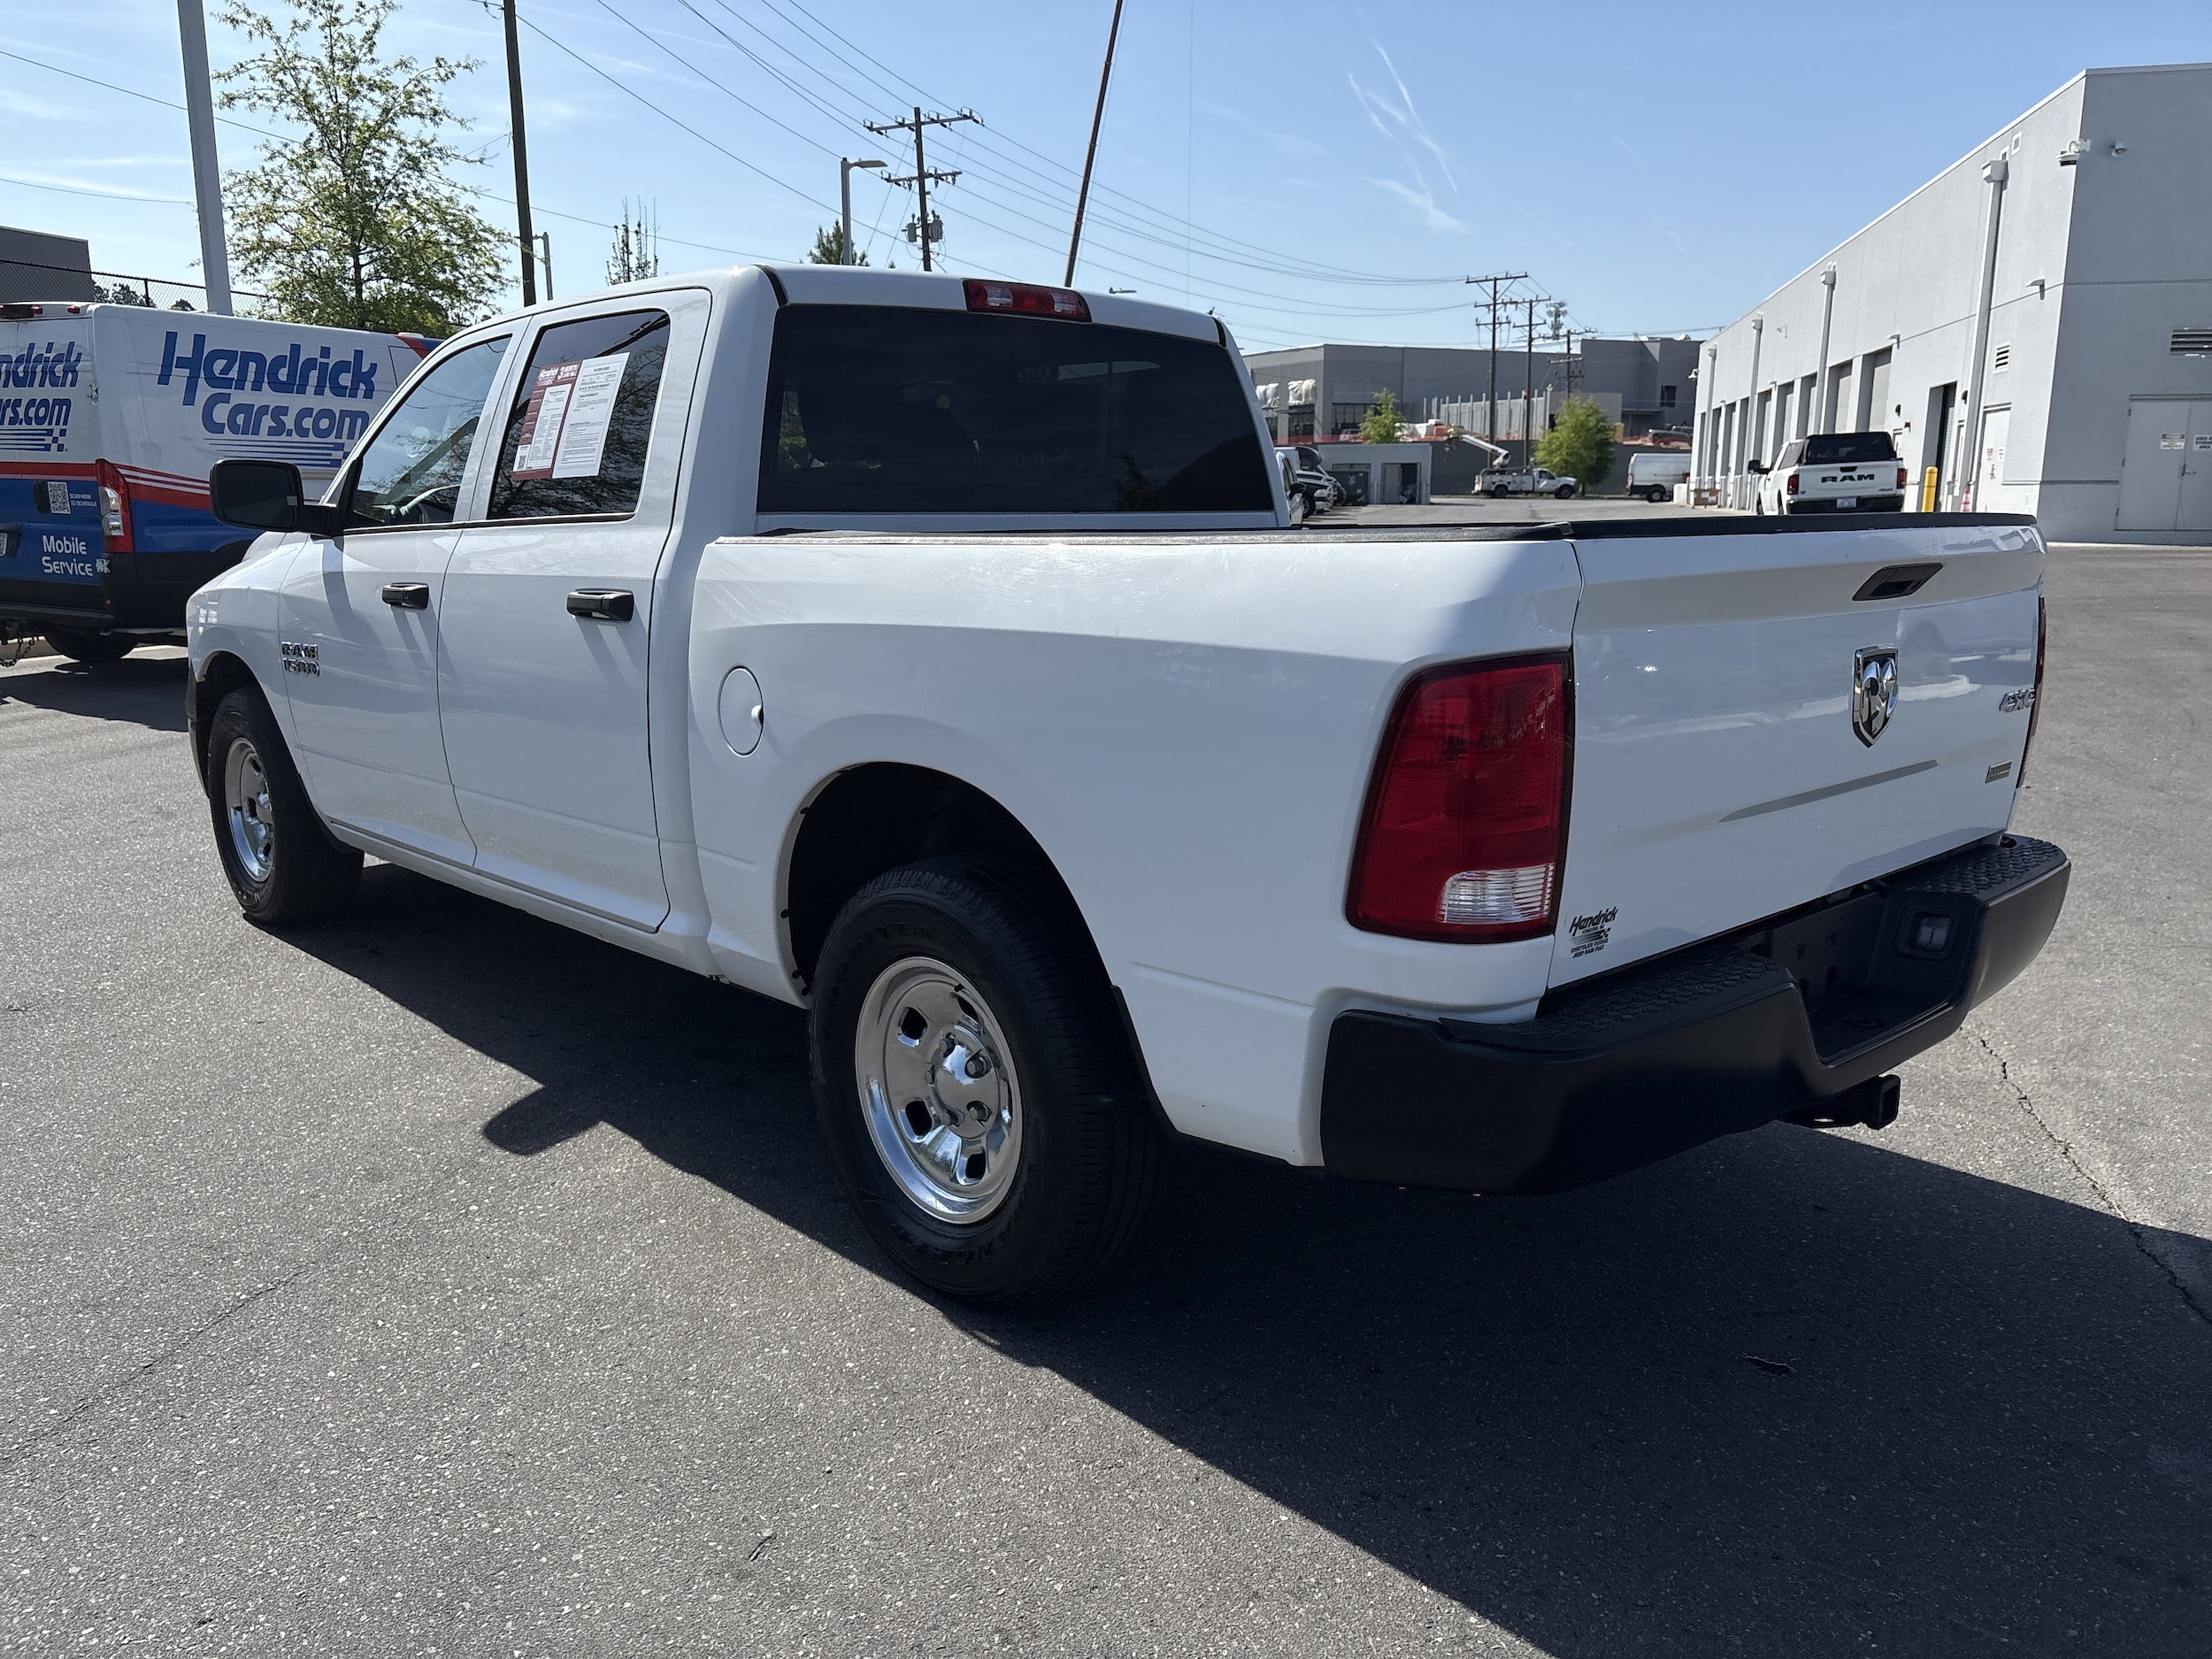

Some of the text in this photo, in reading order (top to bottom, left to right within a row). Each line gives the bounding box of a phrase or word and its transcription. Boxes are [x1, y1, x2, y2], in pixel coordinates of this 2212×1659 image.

[157, 331, 378, 406] Hendrick
[0, 398, 72, 426] rs.com
[202, 393, 370, 440] Cars.com
[1821, 474, 1875, 483] RAM
[42, 534, 88, 556] Mobile
[42, 556, 94, 577] Service
[281, 641, 319, 658] RAM
[282, 657, 320, 677] 1500
[1569, 906, 1618, 937] Hendrick
